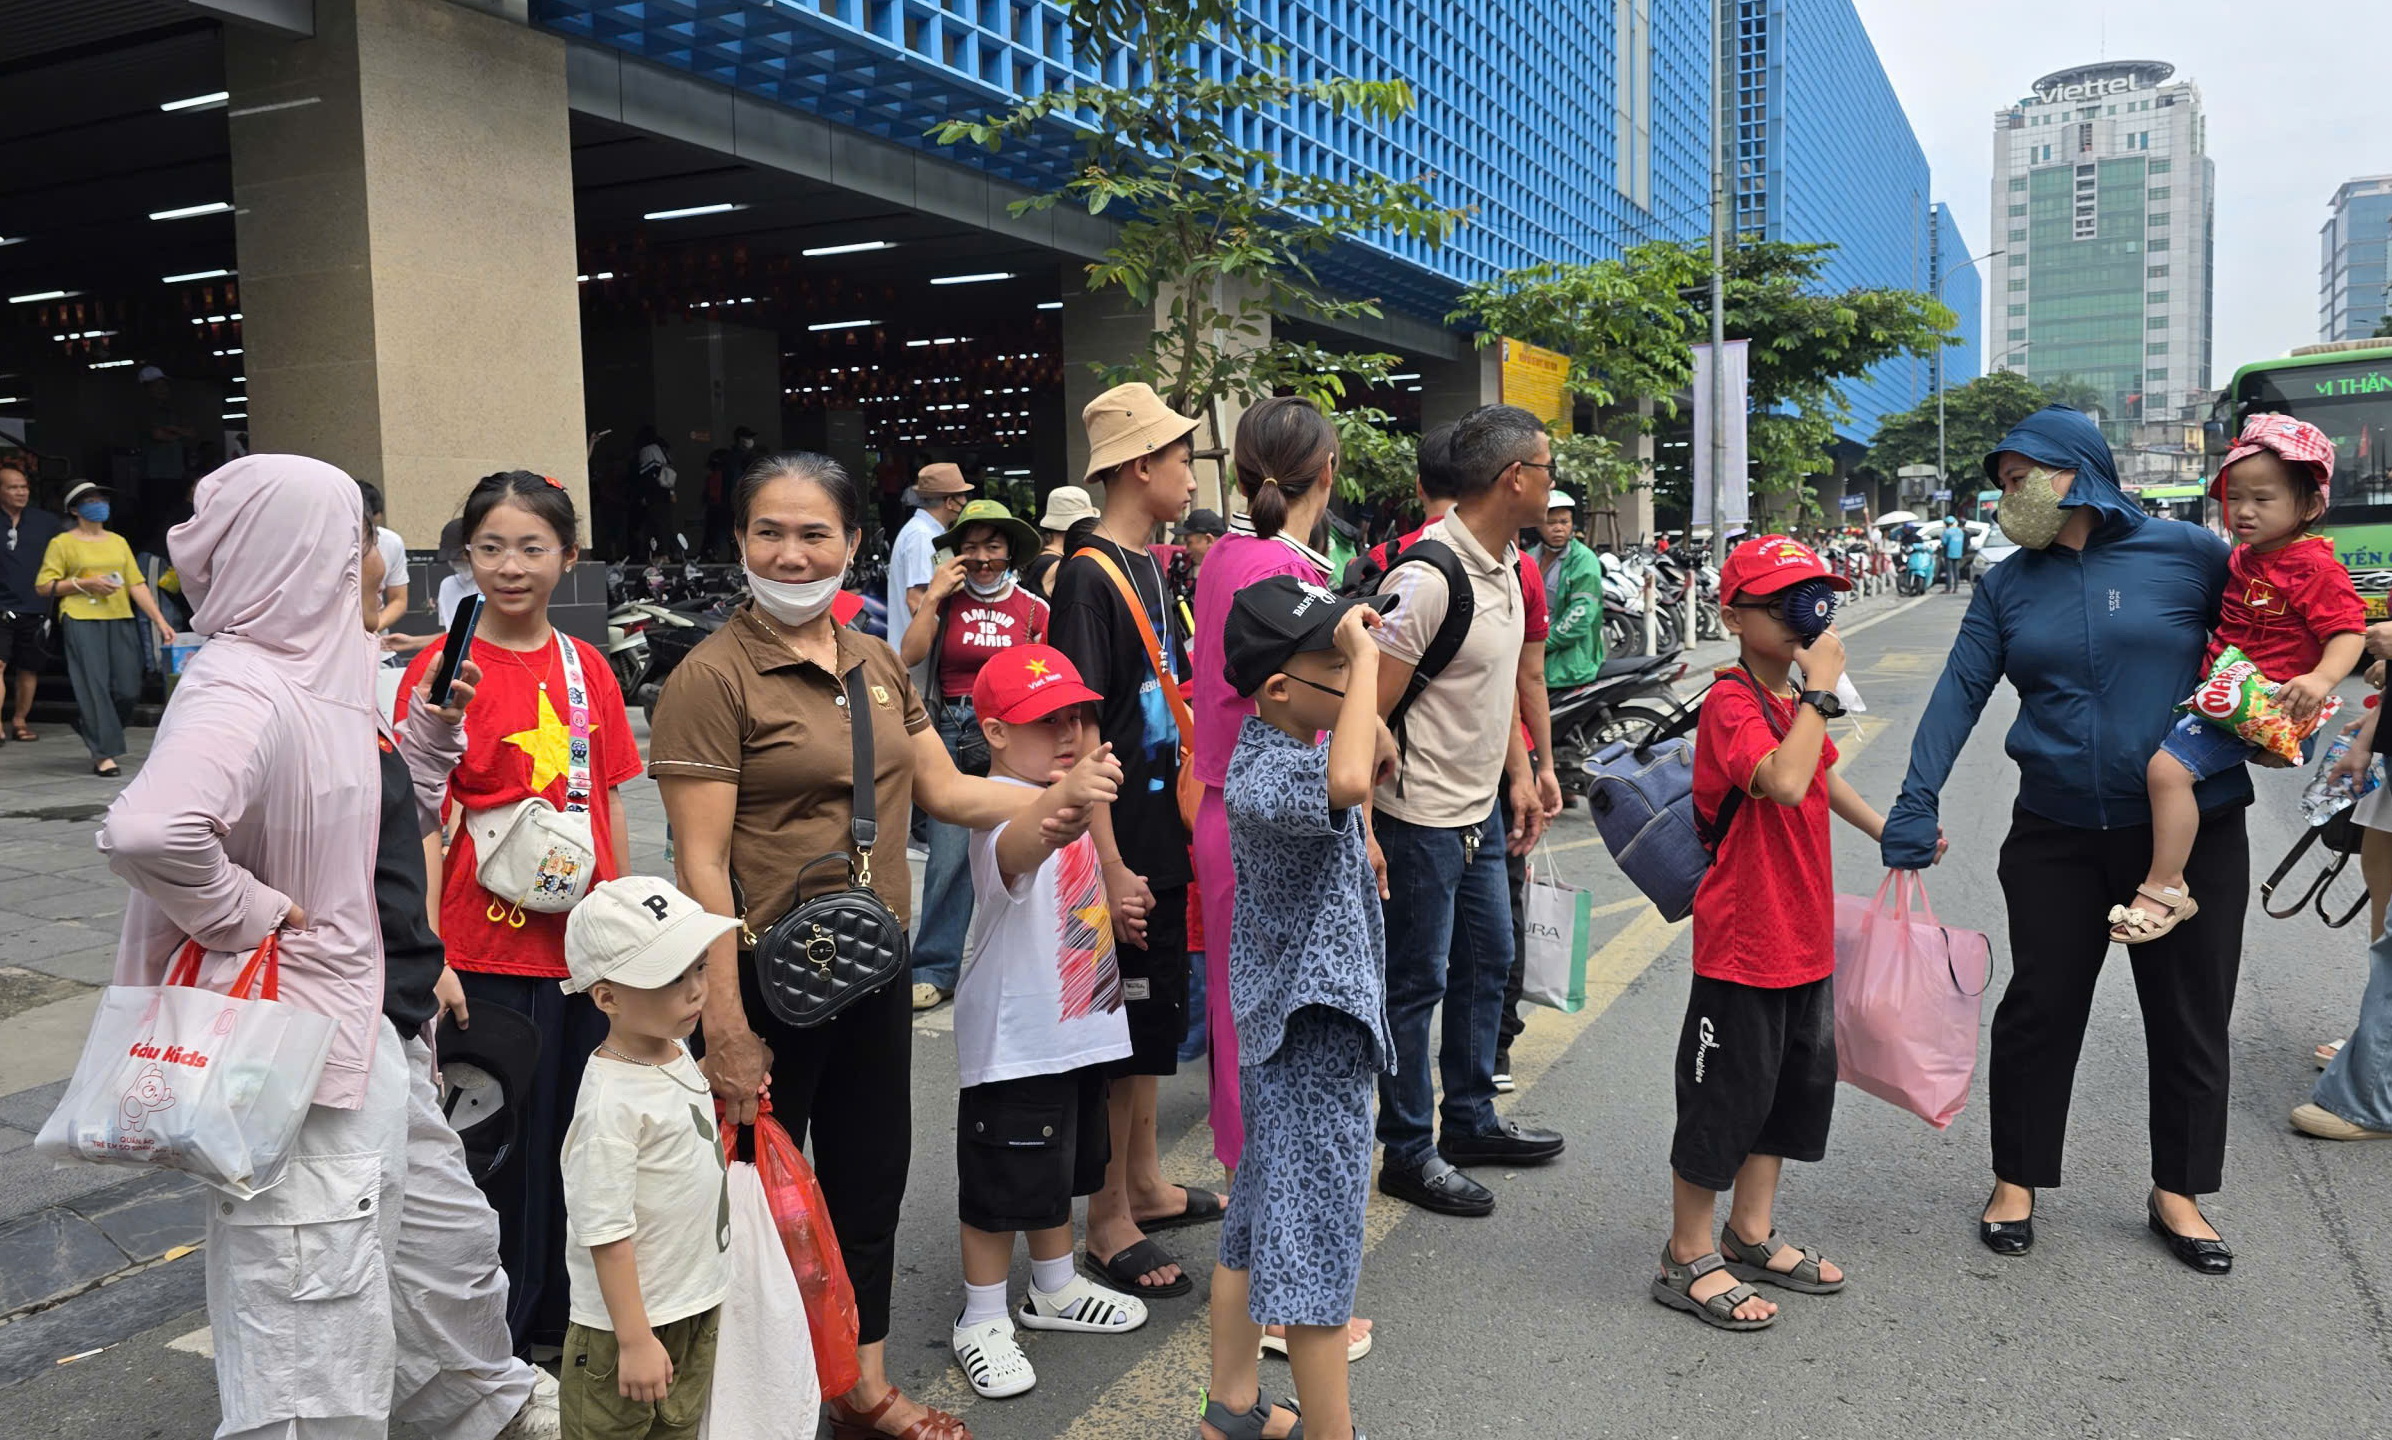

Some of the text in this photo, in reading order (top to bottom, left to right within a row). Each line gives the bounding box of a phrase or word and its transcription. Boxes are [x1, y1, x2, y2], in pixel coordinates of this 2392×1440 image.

[2036, 73, 2140, 104] viettel
[1292, 592, 1317, 617] RALPH
[960, 608, 1016, 629] AMOUR
[977, 621, 998, 635] 15
[962, 631, 1013, 648] PARIS
[641, 894, 669, 922] P
